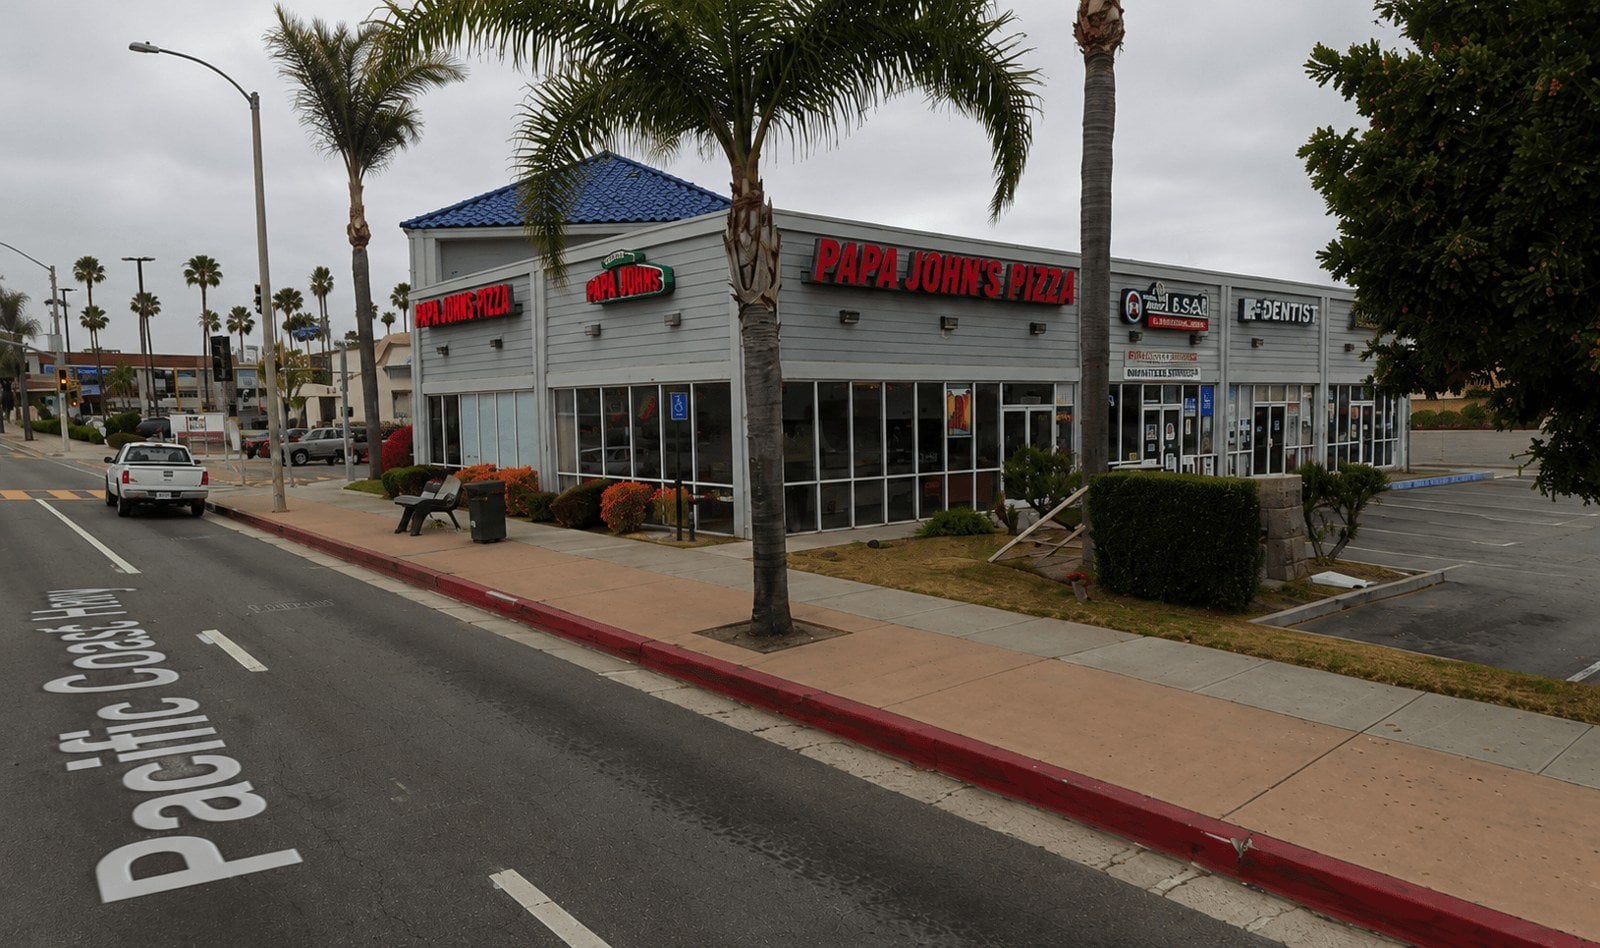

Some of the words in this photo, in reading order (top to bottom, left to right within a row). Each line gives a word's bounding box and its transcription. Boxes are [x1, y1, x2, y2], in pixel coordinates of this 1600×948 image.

[587, 270, 616, 304] PAPA
[813, 238, 898, 289] PAPA
[905, 250, 1003, 299] JOHN'S
[1007, 263, 1075, 305] PIZZA
[415, 299, 439, 328] PAPA
[476, 283, 509, 318] PIZZA
[1263, 300, 1319, 323] DENTIST
[36, 620, 179, 694] Coast
[59, 697, 303, 903] Pacific
